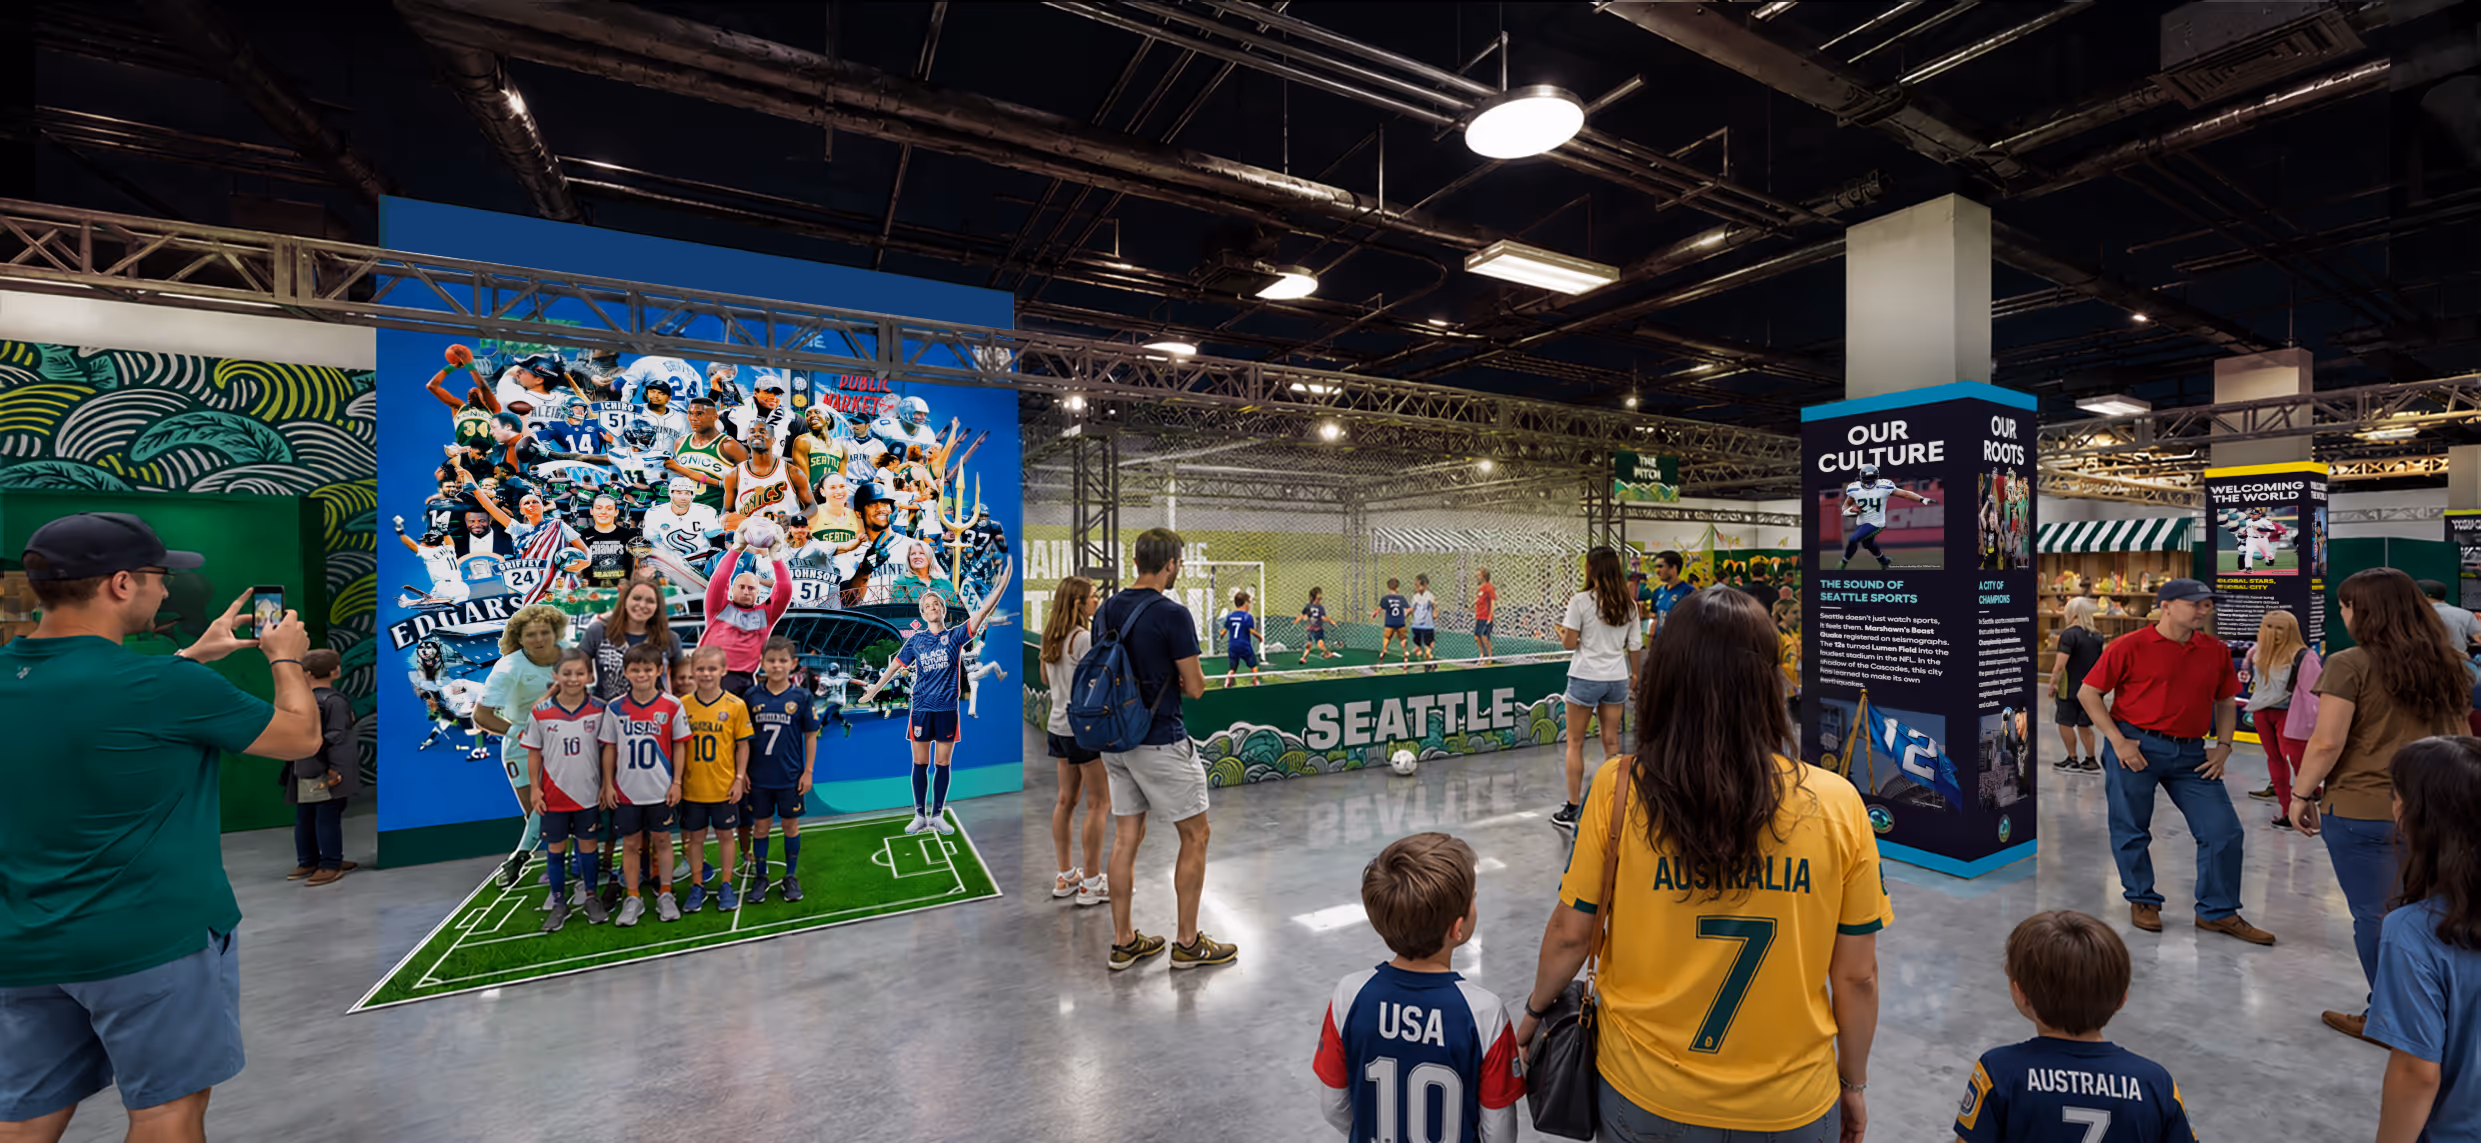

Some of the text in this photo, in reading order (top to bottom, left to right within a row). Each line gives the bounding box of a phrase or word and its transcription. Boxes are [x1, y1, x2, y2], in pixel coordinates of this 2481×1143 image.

[839, 375, 892, 392] PUBLIC
[601, 402, 634, 410] ICHIRO
[823, 393, 881, 415] MARKET
[609, 414, 625, 428] 51
[1991, 416, 2017, 440] OUR
[1848, 420, 1909, 445] OUR
[566, 434, 594, 454] 14
[1818, 440, 1944, 473] CULTURE
[1983, 440, 2024, 466] ROOTS
[2210, 481, 2304, 494] WELCOMING
[1857, 498, 1881, 513] 24
[2213, 494, 2240, 503] THE
[2243, 491, 2299, 502] WORLD
[498, 559, 541, 571] GRIFFEY
[511, 570, 535, 586] 24
[1820, 580, 1904, 590] THE SOUND OF
[1979, 581, 2004, 590] A CITY OF
[800, 582, 821, 600] 51
[963, 584, 981, 612] SEA
[1820, 593, 1918, 603] SEATTLE SPORTS
[1979, 595, 2010, 604] CHAMPIONS
[1864, 625, 1910, 634] Marshawn's
[1844, 633, 1879, 641] registered
[1892, 636, 1950, 646] seismographs.
[920, 648, 947, 660] BLACK
[1820, 650, 1845, 658] loudest
[1846, 651, 1875, 660] stadium
[1885, 654, 1897, 662] the
[1899, 655, 1916, 663] NFL.
[1846, 642, 1870, 650] turned
[1872, 644, 1897, 652] Lumen
[1899, 646, 1917, 654] Field
[1918, 647, 1933, 655] into
[1935, 648, 1949, 656] the
[921, 655, 948, 666] FUTURE
[1820, 659, 1847, 667] shadow
[1857, 661, 1869, 669] the
[1870, 663, 1910, 673] Cascades,
[1912, 666, 1926, 674] this
[1928, 668, 1943, 676] city
[1833, 669, 1860, 678] learned
[1870, 672, 1891, 681] make
[1893, 674, 1902, 682] its
[1306, 687, 1514, 750] SEATTLE
[693, 734, 716, 762] 10
[763, 724, 782, 755] 7
[628, 738, 657, 770] 10
[1884, 718, 1938, 783] 12
[1653, 855, 1810, 894] AUSTRALIA
[1688, 915, 1777, 1054] 7
[1379, 1001, 1444, 1047] USA
[2027, 1068, 2143, 1102] AUSTRALIA
[1365, 1056, 1464, 1143] 10
[2062, 1105, 2111, 1143] 7
